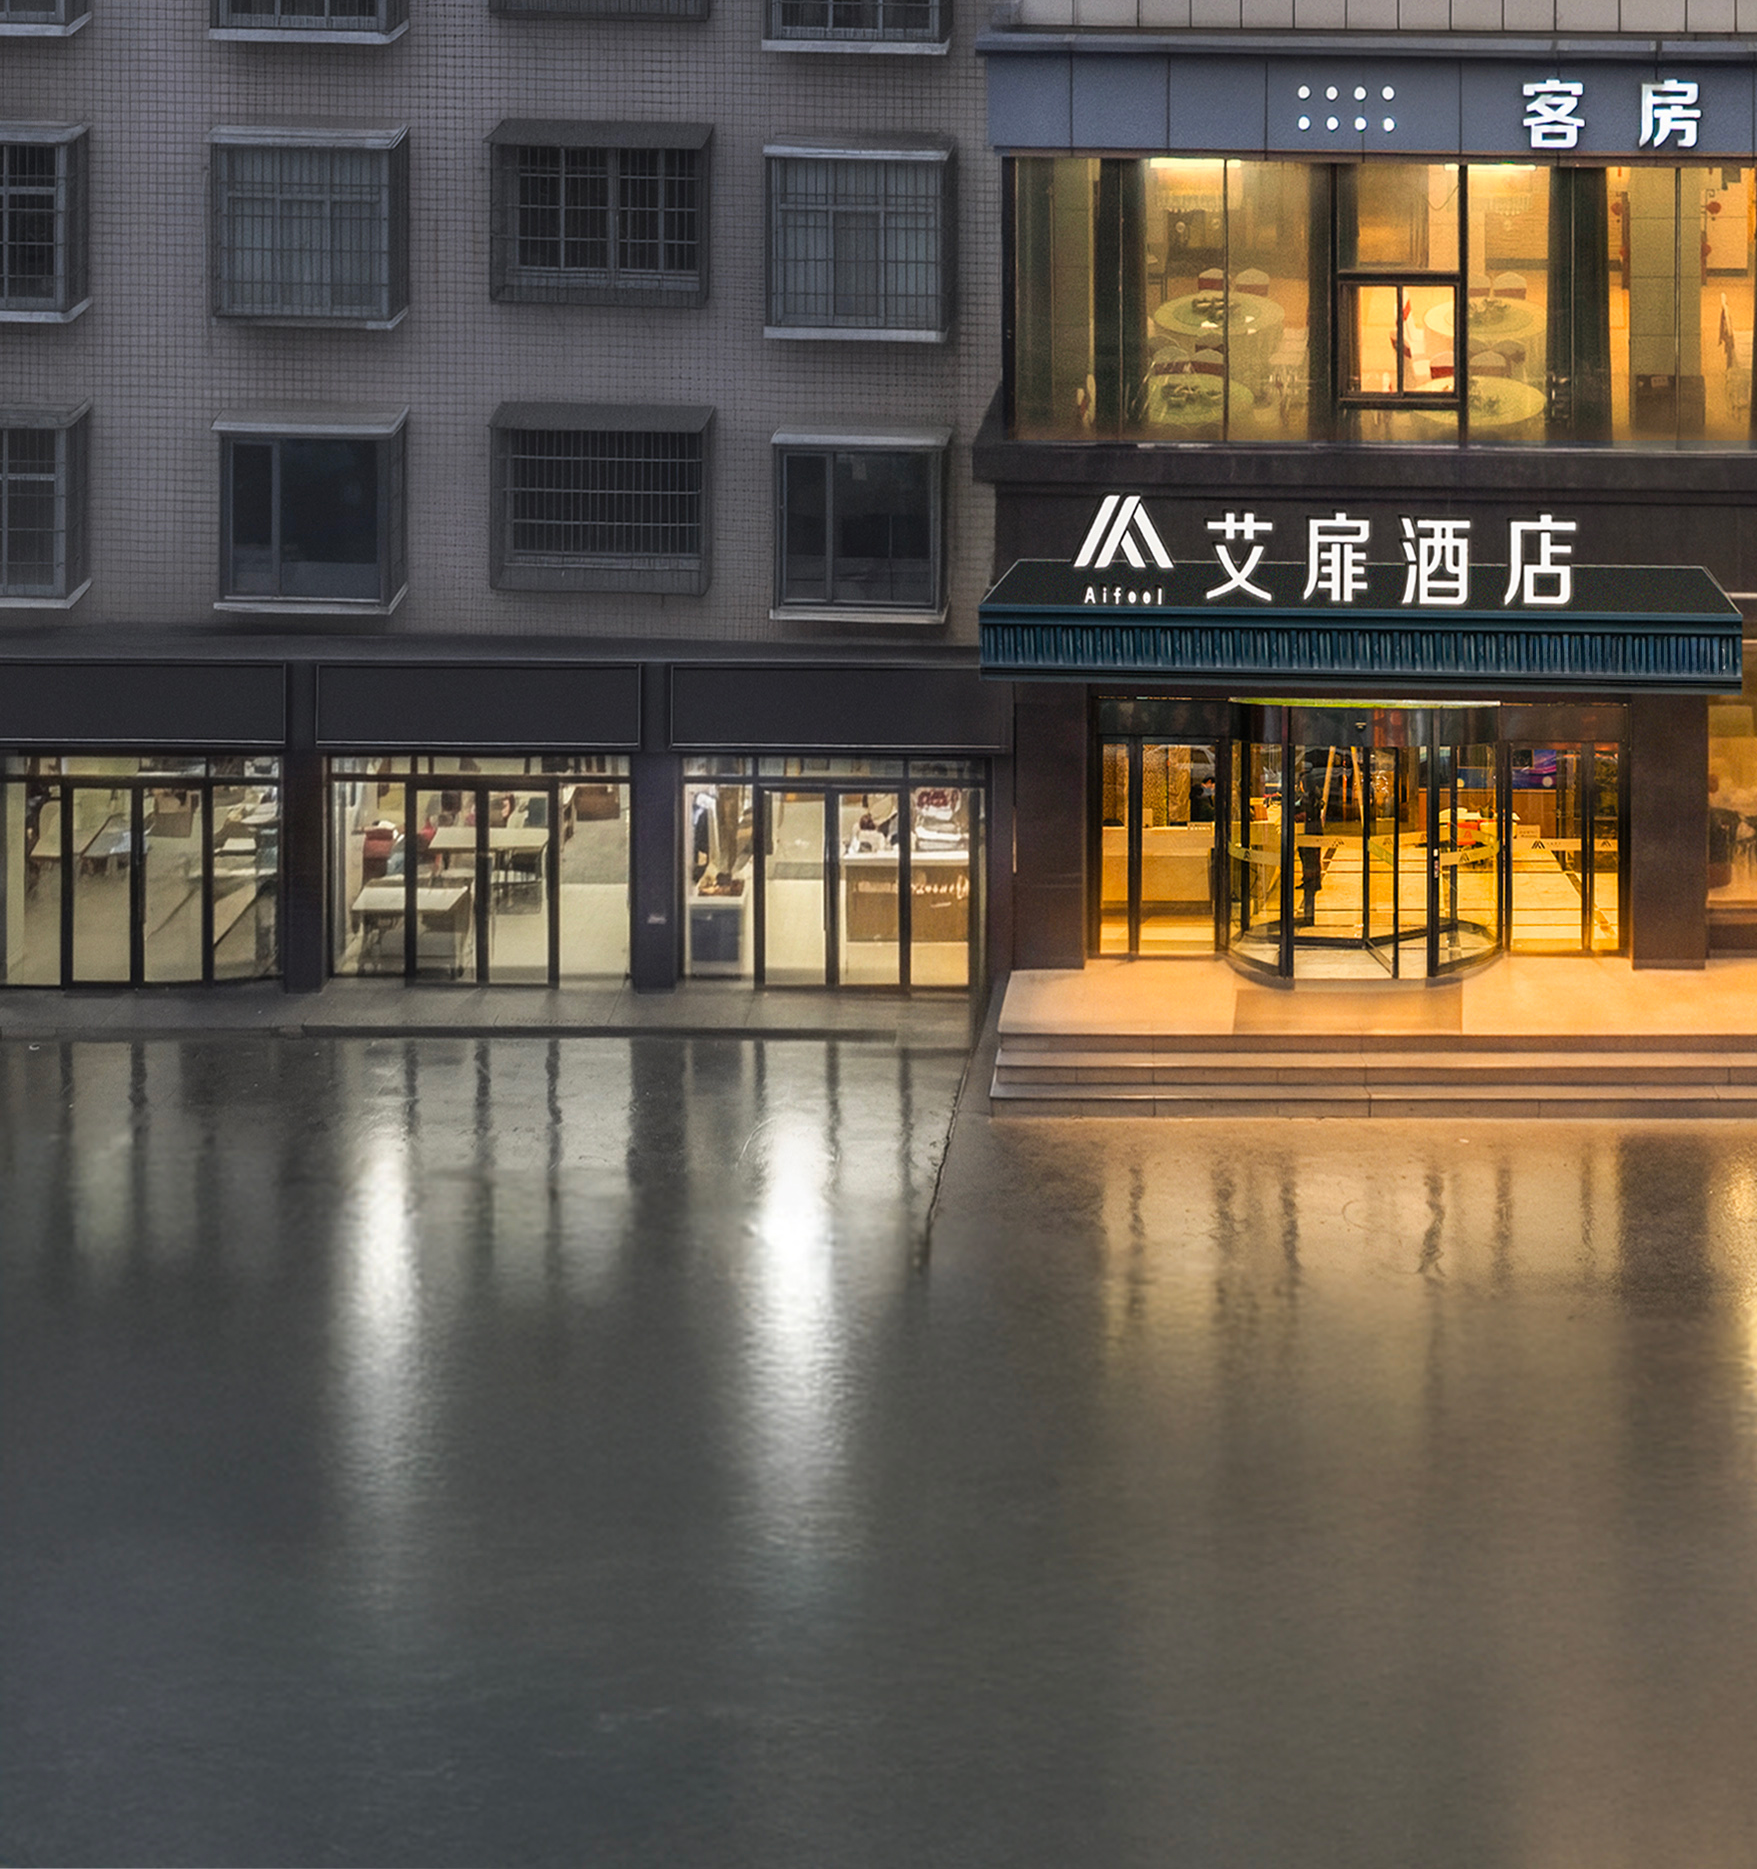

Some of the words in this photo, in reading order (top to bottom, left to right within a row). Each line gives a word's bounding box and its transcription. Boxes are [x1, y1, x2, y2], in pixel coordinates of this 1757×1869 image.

[1522, 79, 1702, 148] 客房
[1206, 512, 1577, 606] 艾扉酒店
